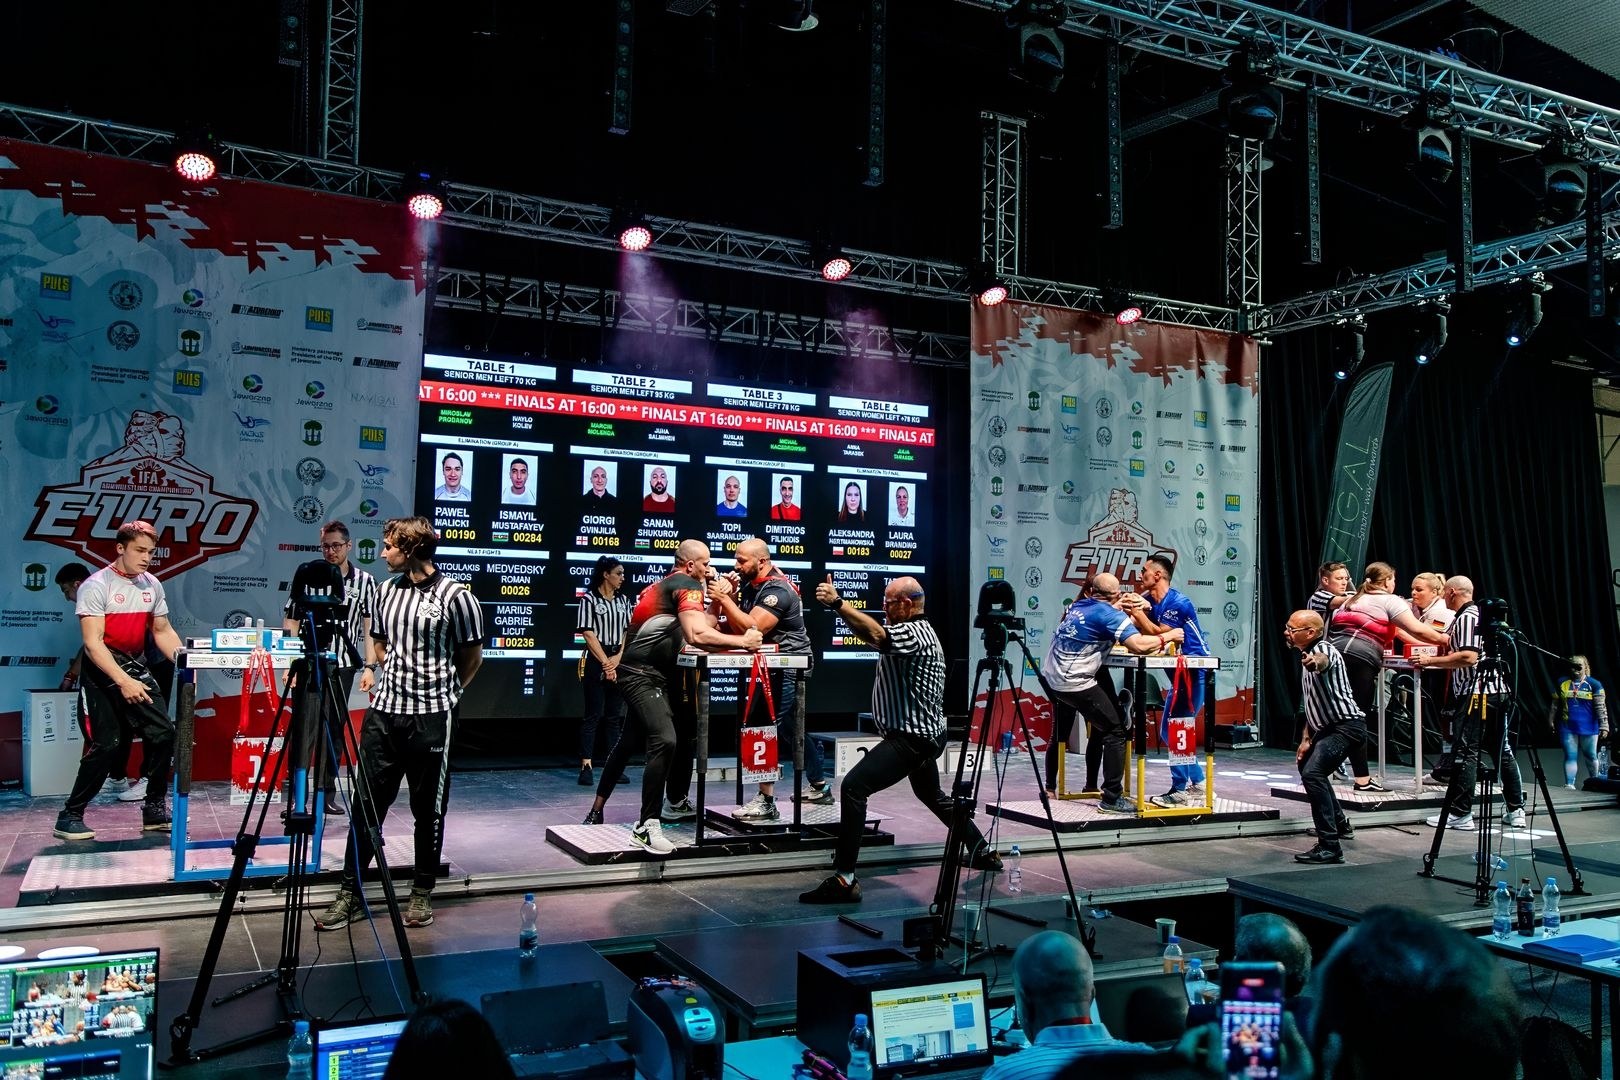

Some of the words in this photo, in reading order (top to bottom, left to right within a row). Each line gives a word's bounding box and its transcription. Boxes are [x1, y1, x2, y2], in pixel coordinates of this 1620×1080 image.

[43, 275, 70, 291] PULS
[174, 307, 212, 317] Jaworzno
[308, 309, 331, 323] PULS
[467, 361, 505, 372] TABLE
[509, 365, 515, 373] 1
[176, 372, 200, 386] PULS
[444, 370, 474, 379] SENIOR
[476, 374, 493, 382] MEN
[612, 376, 646, 387] TABLE
[649, 380, 655, 388] 2
[591, 385, 618, 394] SENIOR
[743, 389, 774, 400] TABLE
[233, 393, 271, 402] Jaworzno
[724, 398, 748, 406] SENIOR
[296, 399, 333, 408] Jaworzno
[862, 401, 890, 411] TABLE
[419, 385, 433, 398] AT
[438, 387, 476, 402] 16:00
[505, 393, 555, 410] FINALS
[558, 397, 577, 412] AT
[580, 400, 616, 416] 16:00
[642, 406, 687, 421] FINALS
[691, 411, 706, 423] AT
[710, 413, 742, 426] 16:00
[766, 418, 807, 432] FINALS
[810, 424, 826, 434] AT
[828, 424, 857, 437] 16:00
[880, 429, 917, 442] FINALS
[920, 432, 933, 443] AT
[441, 409, 471, 417] MIROSLAV
[838, 409, 860, 417] SENIOR
[362, 428, 384, 442] PULS
[458, 437, 491, 446] ELIMINATION
[139, 472, 158, 484] IFA
[34, 492, 253, 543] EURO
[435, 507, 470, 518] PAWEL
[500, 511, 537, 521] ISMAYIL
[352, 517, 385, 525] Jaworzno
[435, 518, 470, 528] MALICKI
[583, 515, 615, 524] GIORGI
[643, 518, 674, 528] SANAN
[492, 522, 544, 531] MUSTAFAYEV
[722, 523, 741, 532] TOPI
[765, 524, 805, 535] DIMITRIOS
[446, 529, 476, 540] 00190
[513, 532, 542, 543] 00284
[638, 529, 679, 537] SHUKUROV
[829, 529, 875, 538] ALEKSANDRA
[889, 531, 914, 540] LAURA
[592, 536, 620, 546] 00168
[654, 539, 680, 548] 00282
[771, 535, 800, 543] FILIKIDIS
[885, 541, 917, 549] BRANDING
[847, 547, 870, 555] 00183
[890, 550, 912, 558] 00027
[486, 564, 546, 575] MEDVEDSKY
[647, 564, 666, 573] ALA-
[501, 576, 530, 584] ROMAN
[834, 571, 868, 580] RENLUND
[501, 585, 530, 595] 00026
[833, 581, 869, 589] BERGMAN
[497, 606, 532, 615] MARIUS
[495, 616, 534, 626] GABRIEL
[502, 627, 525, 635] LICUT
[505, 637, 534, 648] 00236
[1177, 730, 1186, 750] 3
[754, 742, 766, 765] 2
[966, 754, 975, 767] 3
[248, 755, 265, 783] 1
